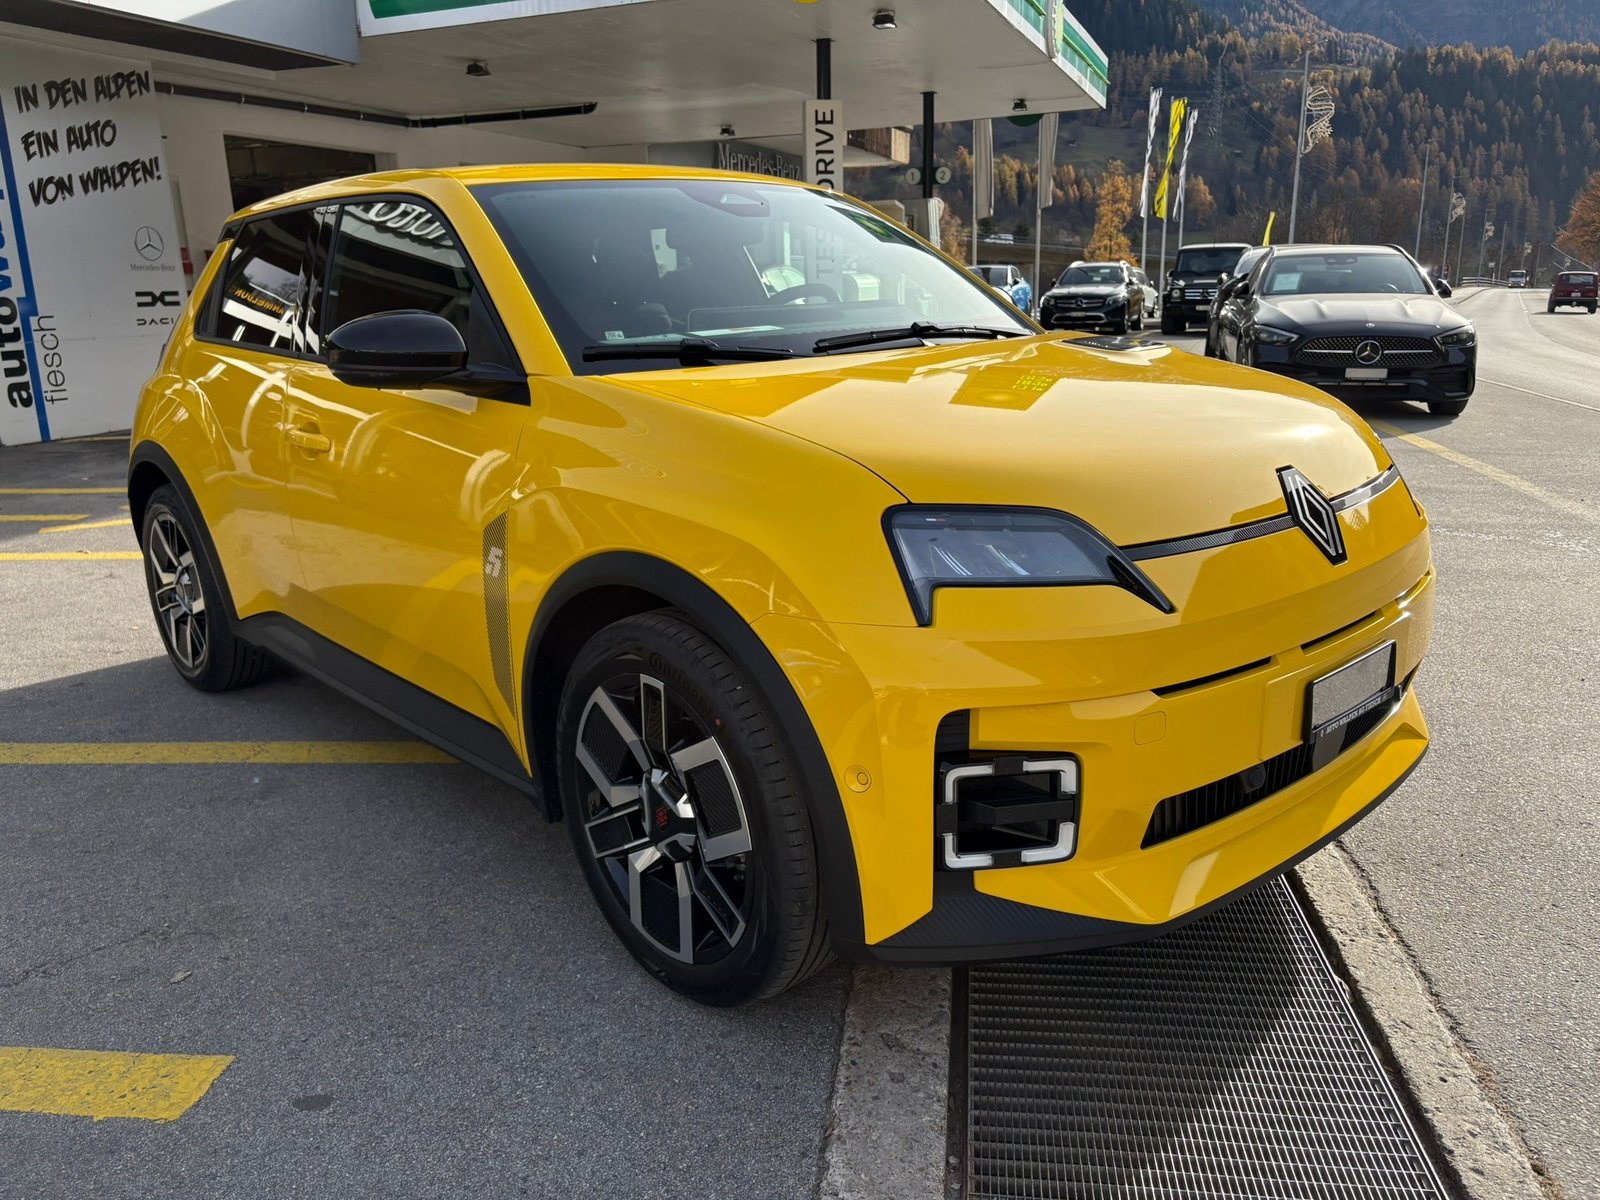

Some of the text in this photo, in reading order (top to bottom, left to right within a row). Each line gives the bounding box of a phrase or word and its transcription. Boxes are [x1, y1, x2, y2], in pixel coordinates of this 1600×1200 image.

[14, 70, 151, 114] IN DEN ALPEN
[20, 119, 117, 161] EIN AUTO
[718, 142, 801, 180] Mercedes-Benz
[28, 156, 162, 207] VON WALPEN!
[130, 263, 176, 272] Mercedes-Benz
[136, 317, 174, 326] DACI
[33, 315, 68, 405] fiesch
